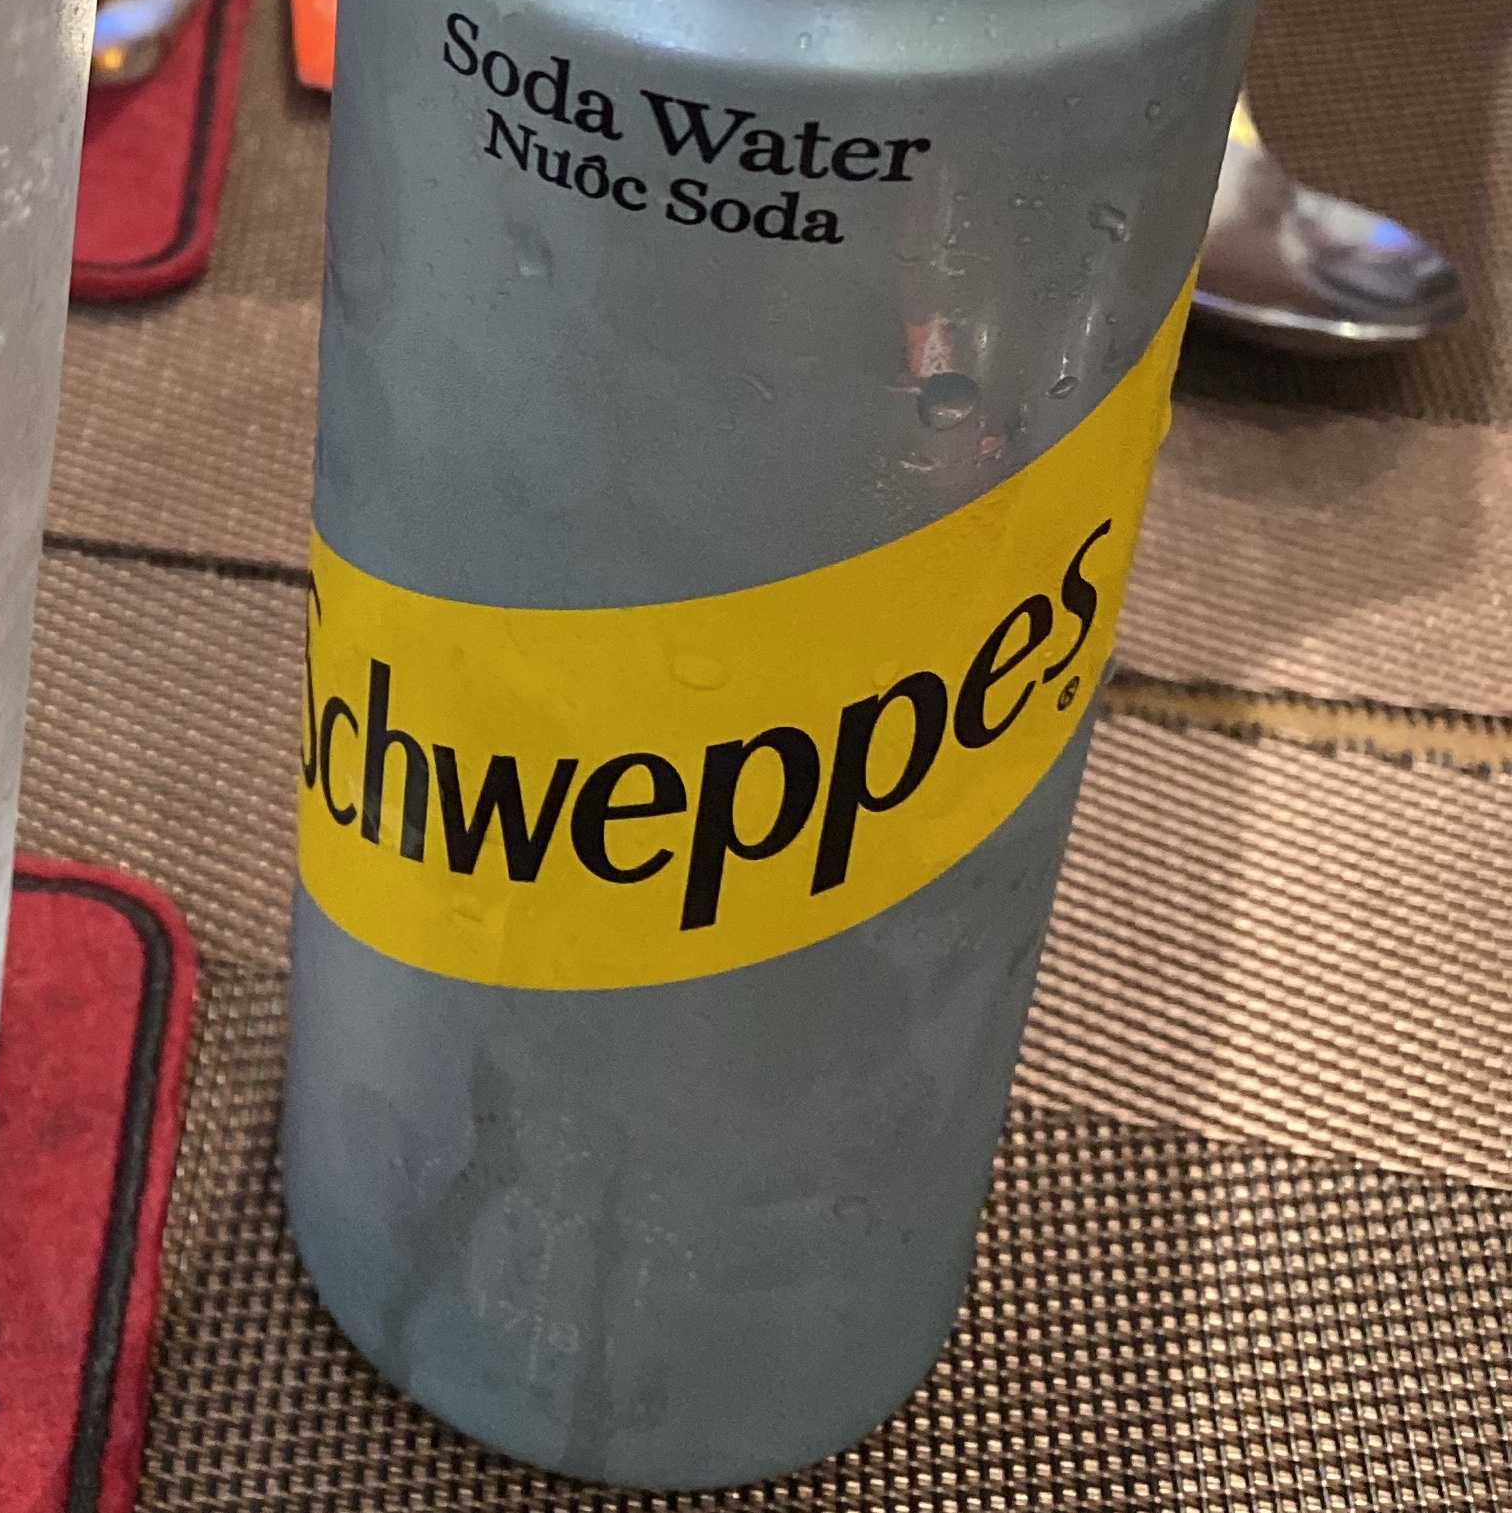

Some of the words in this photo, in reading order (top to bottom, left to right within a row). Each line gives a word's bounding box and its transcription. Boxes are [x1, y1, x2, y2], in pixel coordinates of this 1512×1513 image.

[443, 13, 623, 141] Soda
[640, 90, 931, 183] Water
[665, 178, 844, 245] Soda
[300, 519, 1112, 932] Schweppes
